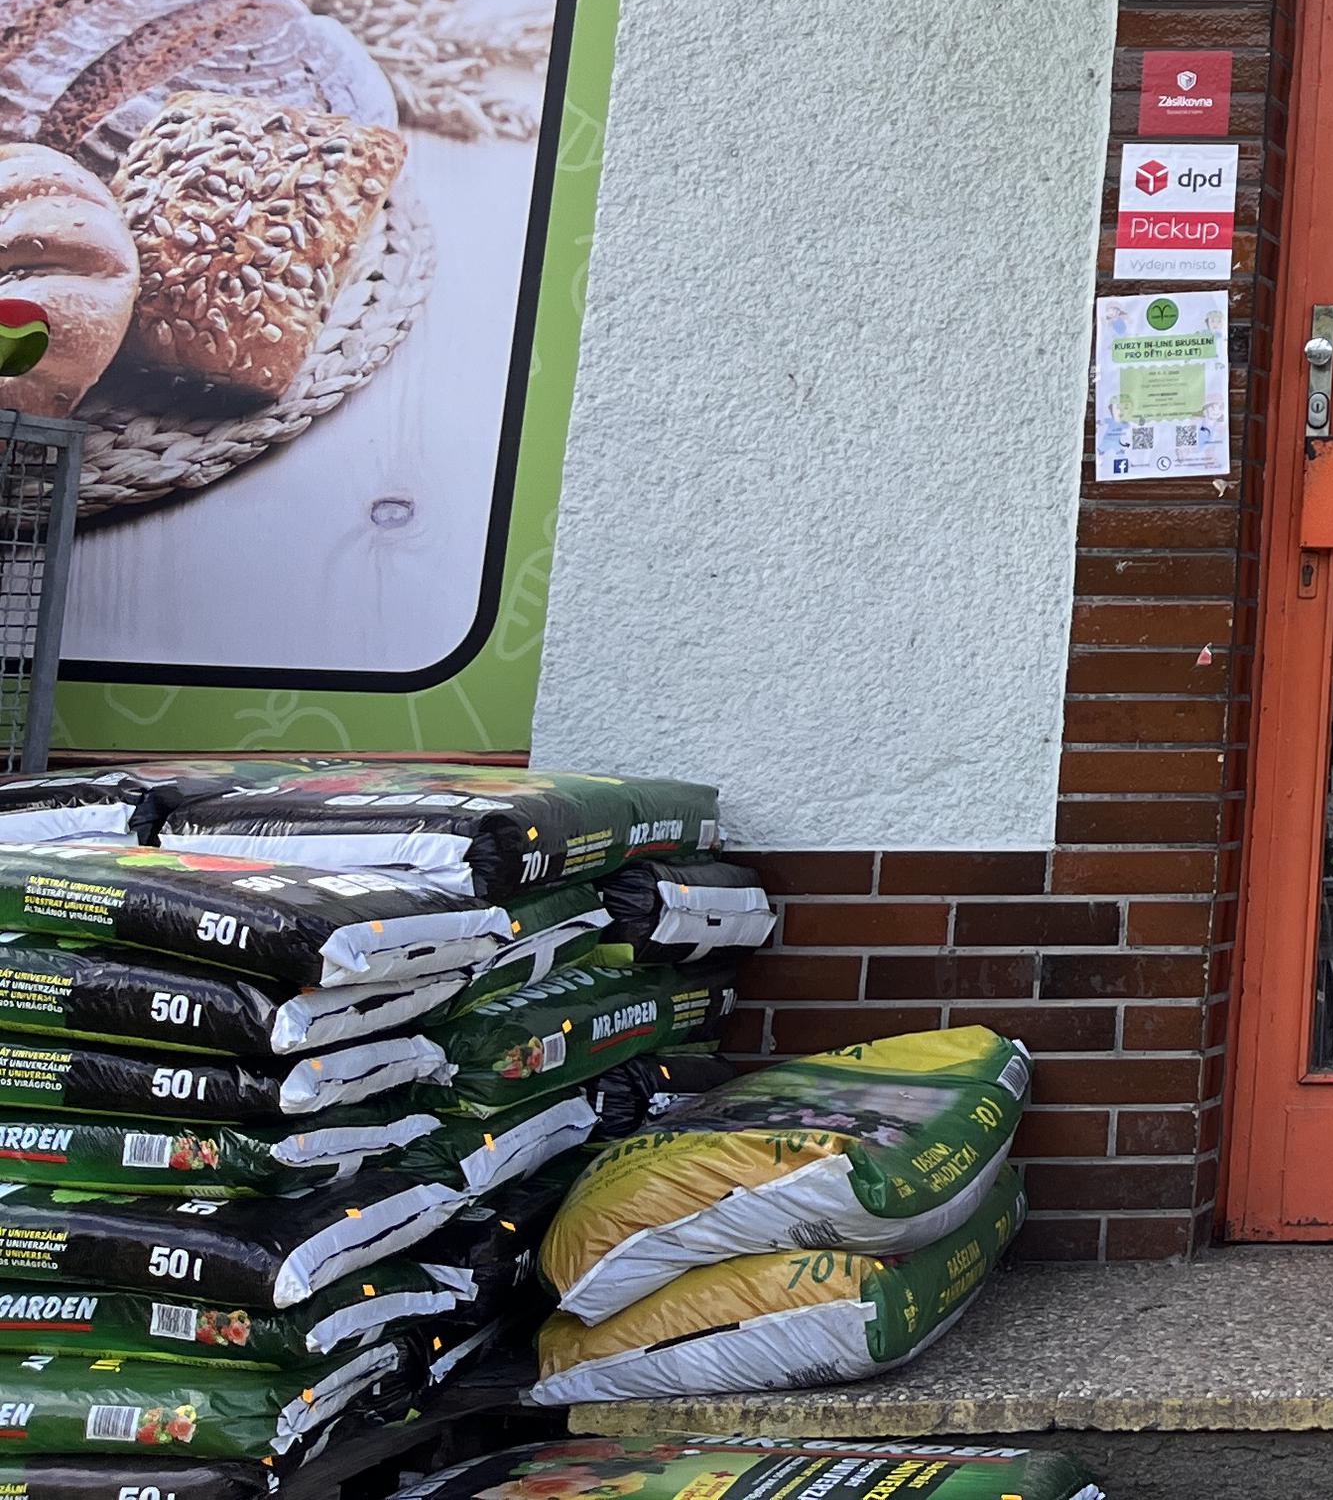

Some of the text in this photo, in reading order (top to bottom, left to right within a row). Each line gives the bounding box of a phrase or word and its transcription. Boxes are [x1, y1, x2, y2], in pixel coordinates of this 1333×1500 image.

[1178, 167, 1222, 193] dpd
[1130, 217, 1219, 244] Pickup
[1130, 259, 1216, 271] Výdejní místo
[1114, 336, 1214, 351] KURZY IN-LINE BRUSLENÍ
[1125, 351, 1142, 359] PRO
[1144, 349, 1162, 358] DĚTI
[520, 852, 541, 884] 70
[196, 910, 237, 945] 50
[150, 992, 190, 1024] 50
[592, 1000, 658, 1041] MR.GARDEN
[12, 1049, 72, 1062] UNIVERZÁLNÍ
[9, 1059, 72, 1072] UNIVERZÁLNY
[8, 1069, 57, 1080] UNIVERSAL
[14, 1079, 62, 1091] VIRÁGFÖLD
[151, 1068, 193, 1099] 50
[8, 1228, 69, 1241] UNIVERZÁLNÍ
[6, 1239, 67, 1251] UNIVERZÁLNY
[5, 1249, 52, 1260] UNIVERSAL
[11, 1259, 58, 1270] VIRÁGFÖLD
[148, 1246, 189, 1279] 50
[788, 1251, 834, 1289] 70
